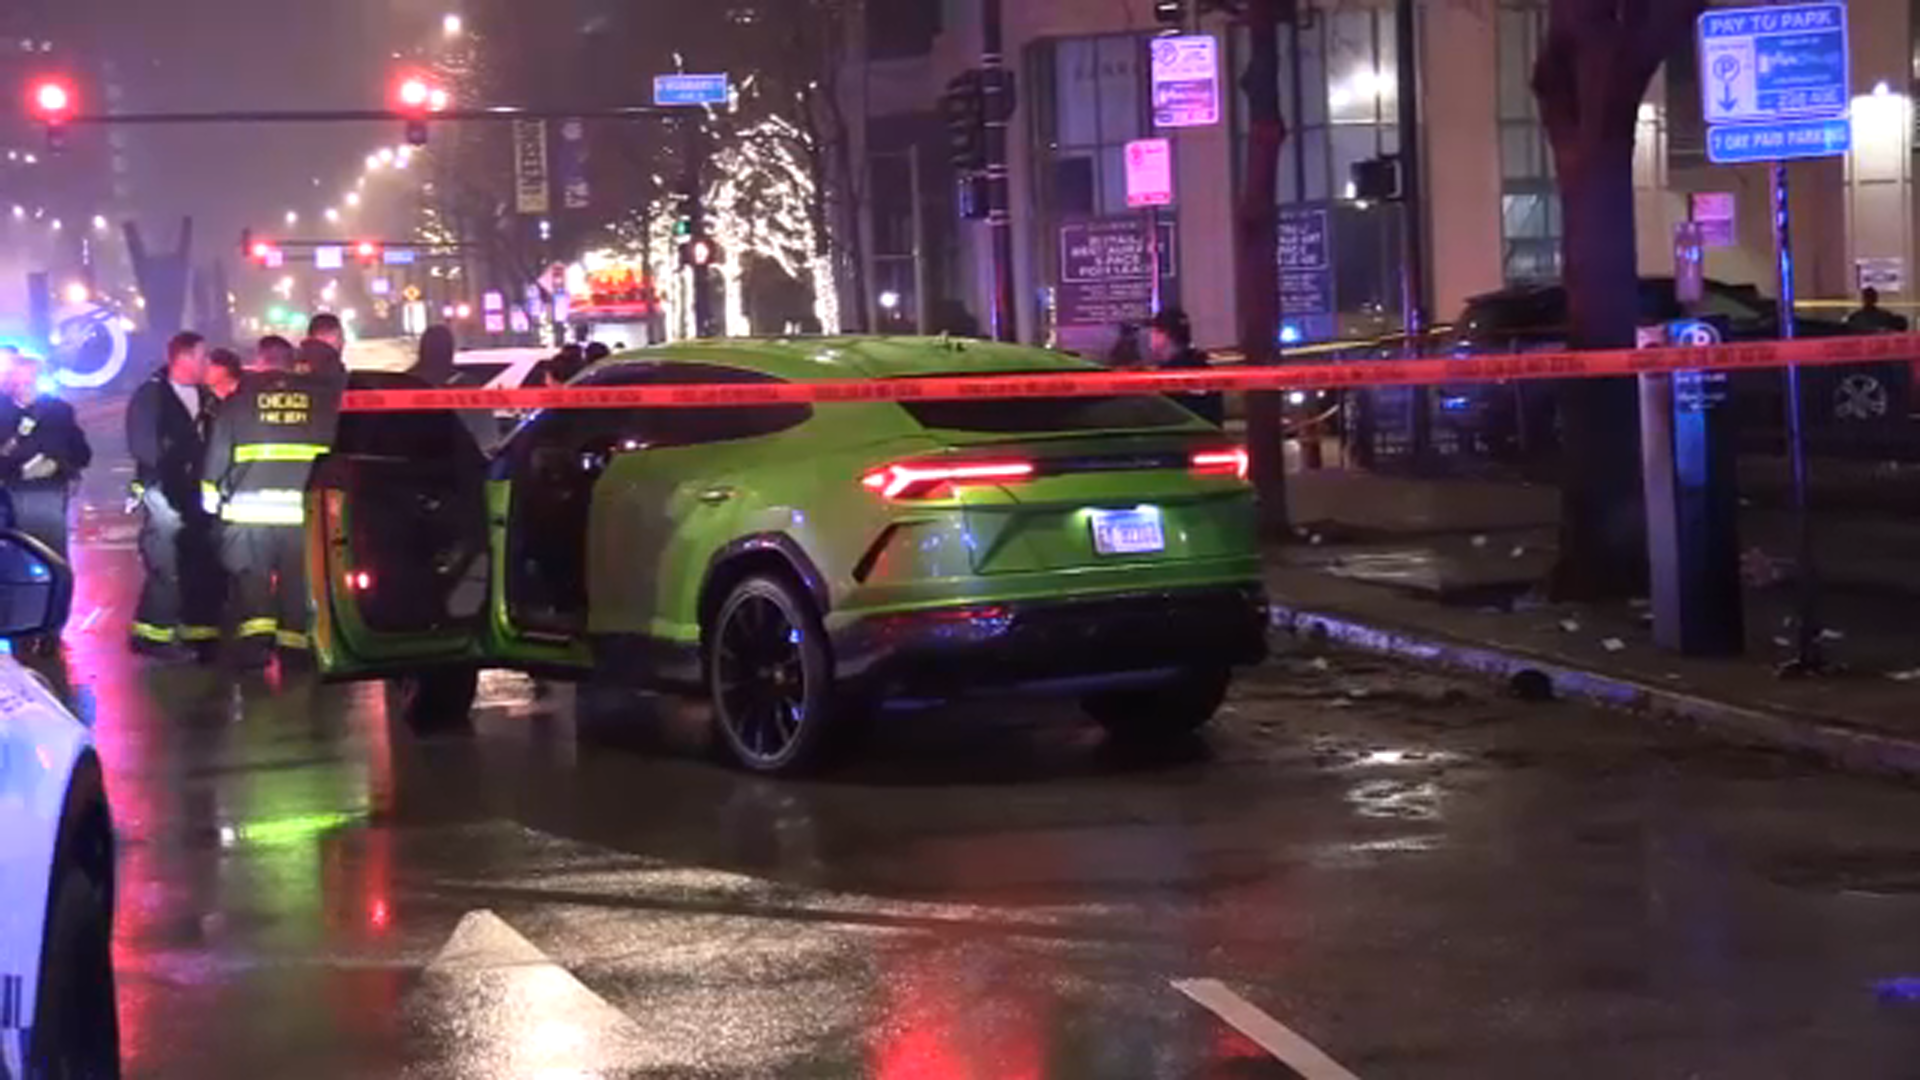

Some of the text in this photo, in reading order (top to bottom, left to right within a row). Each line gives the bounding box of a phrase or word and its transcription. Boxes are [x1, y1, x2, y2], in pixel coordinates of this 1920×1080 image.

[1710, 10, 1832, 34] PAY TO PARK
[257, 392, 309, 409] CHICAGO
